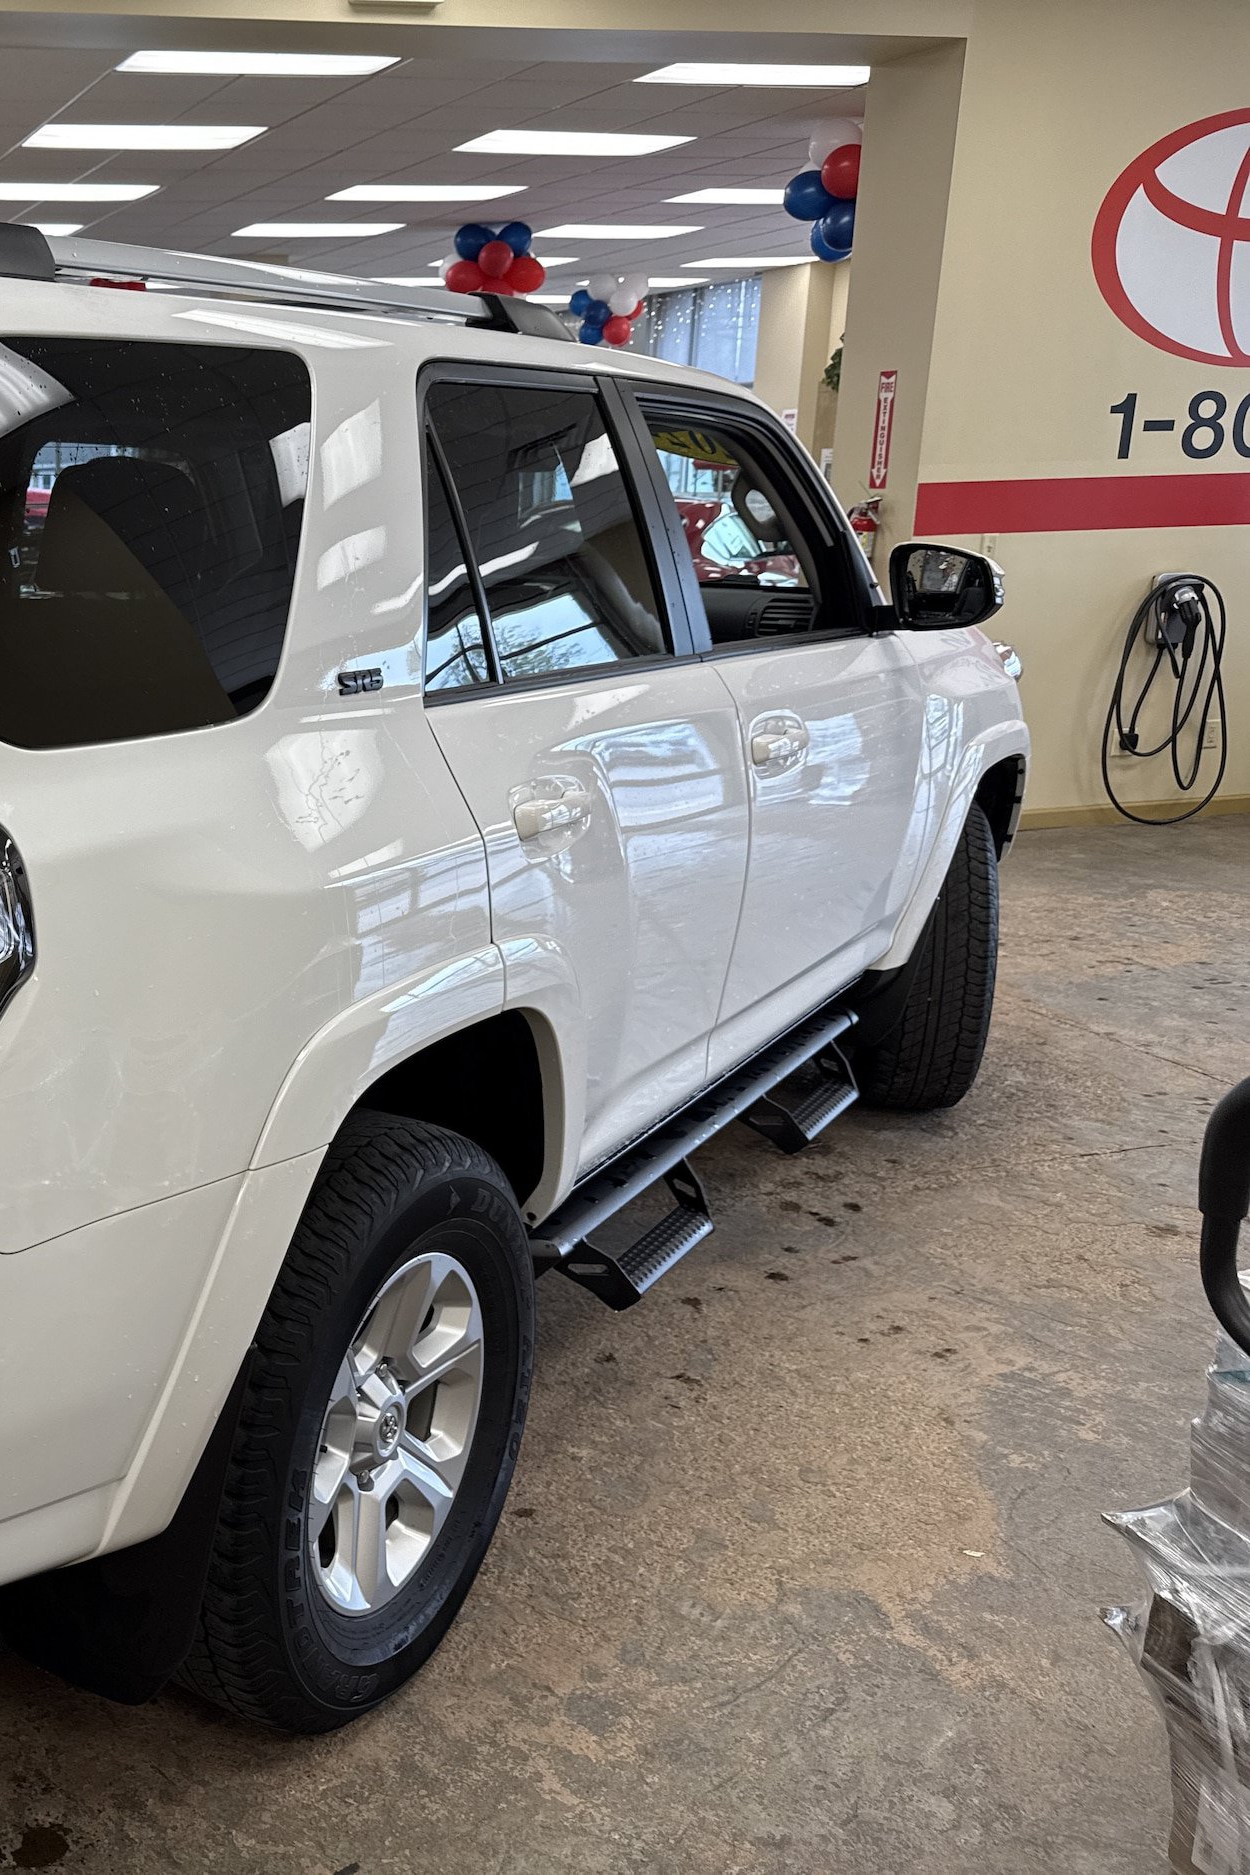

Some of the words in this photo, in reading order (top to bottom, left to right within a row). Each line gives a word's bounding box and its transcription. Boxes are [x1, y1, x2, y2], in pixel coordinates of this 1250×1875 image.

[880, 381, 894, 393] FIRE
[875, 397, 889, 480] EXTINGUISHER
[337, 667, 384, 696] SR5
